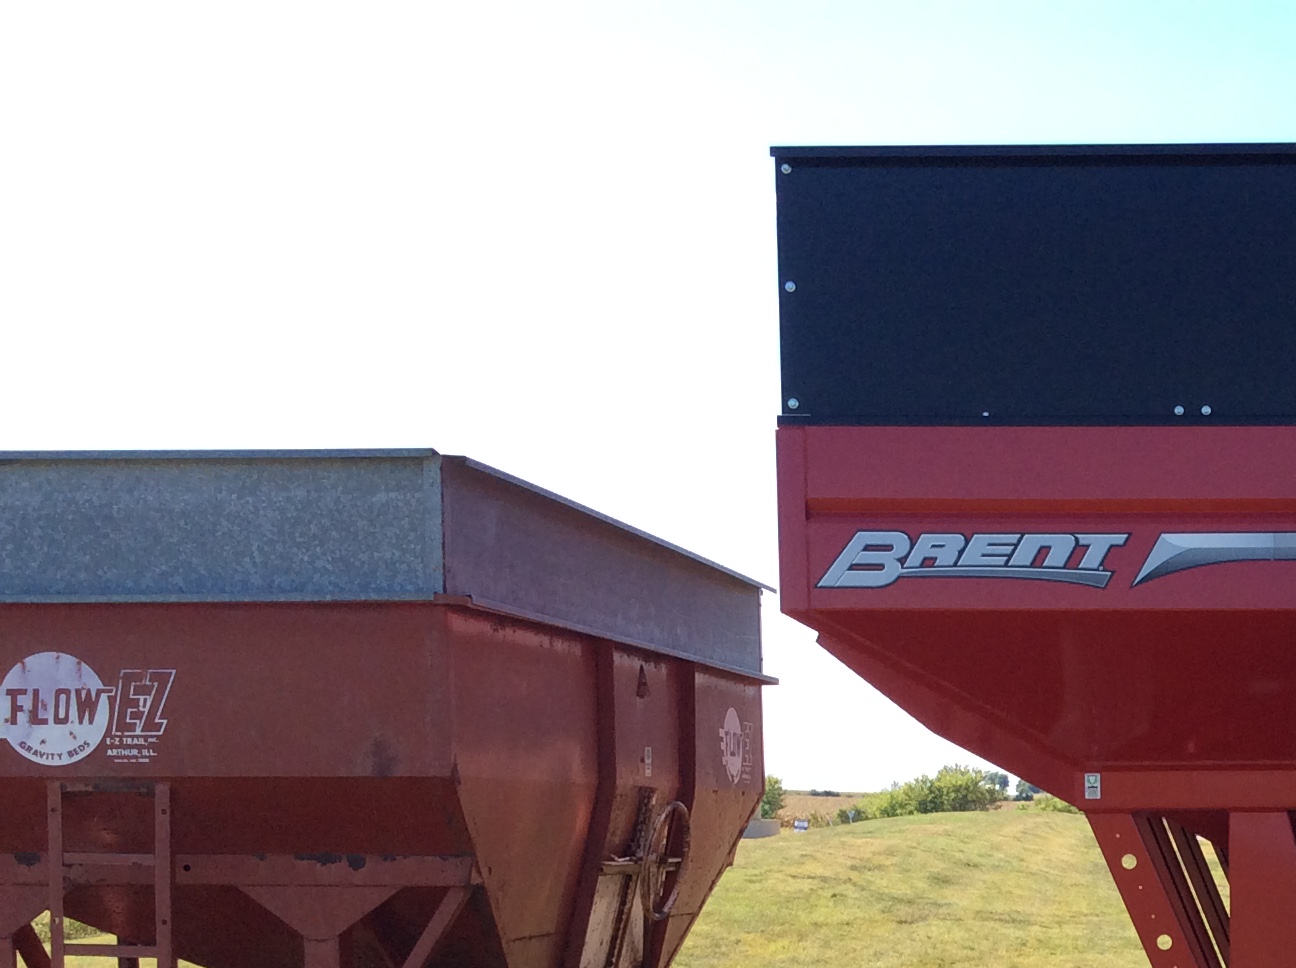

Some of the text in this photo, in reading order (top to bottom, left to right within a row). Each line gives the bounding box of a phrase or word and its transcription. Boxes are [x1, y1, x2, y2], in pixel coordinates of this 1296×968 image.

[814, 530, 1132, 588] BRENT
[5, 669, 177, 735] FLOW EZ
[18, 740, 91, 761] GRAVITY BEDS
